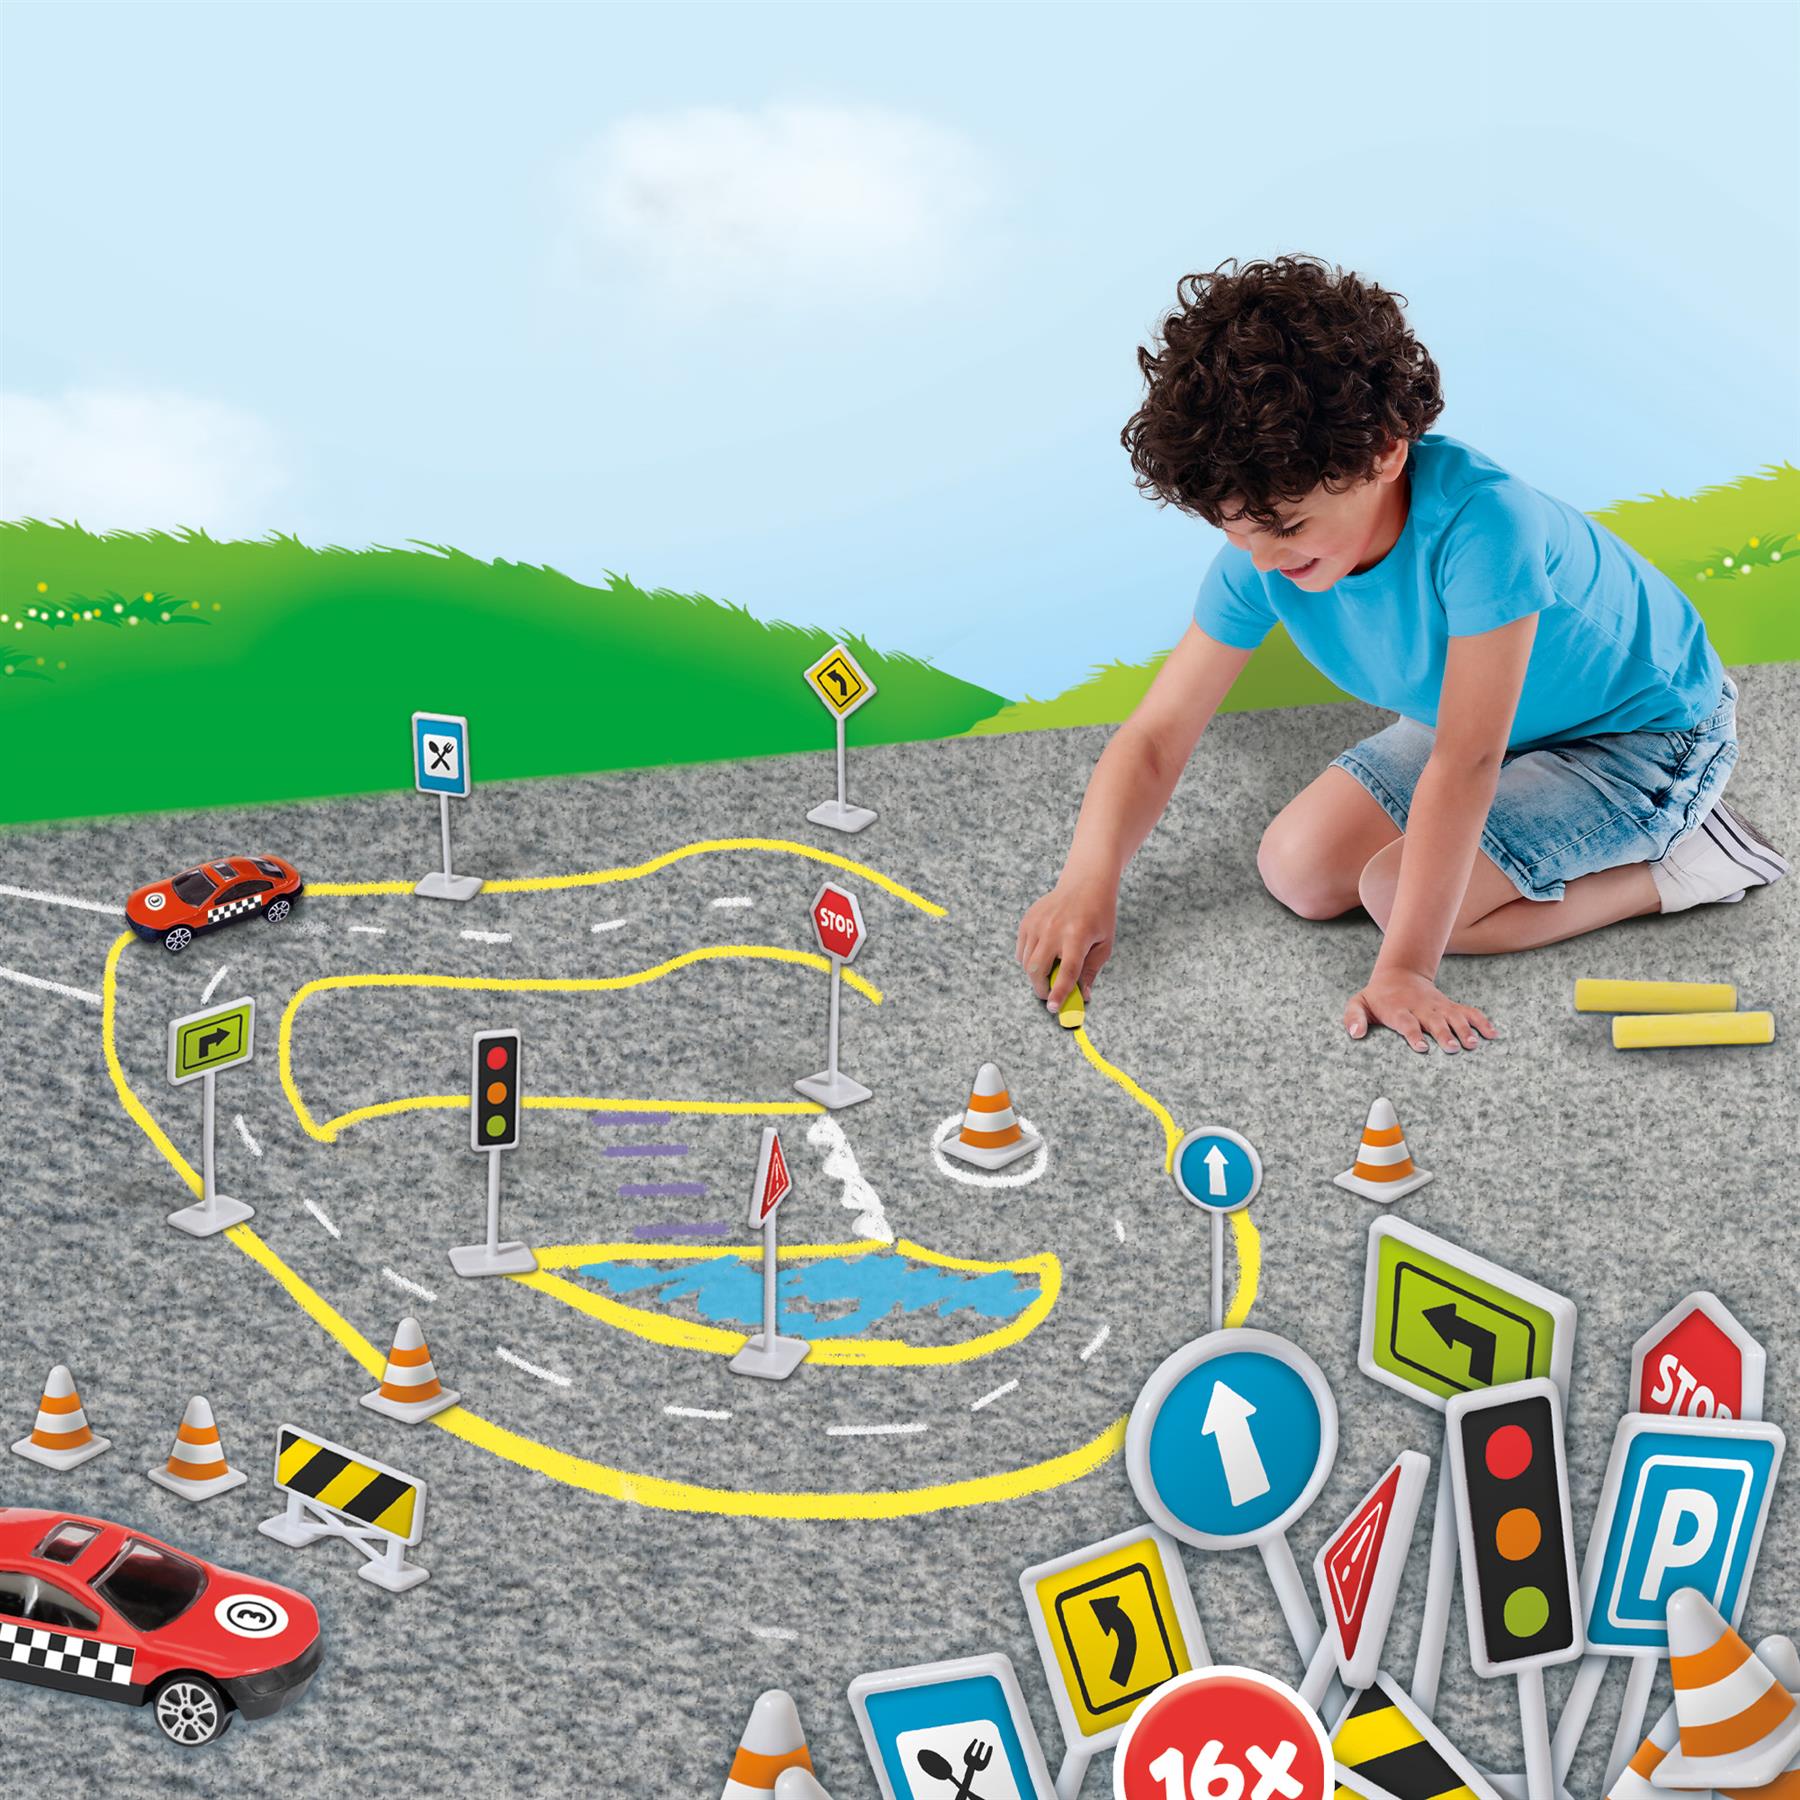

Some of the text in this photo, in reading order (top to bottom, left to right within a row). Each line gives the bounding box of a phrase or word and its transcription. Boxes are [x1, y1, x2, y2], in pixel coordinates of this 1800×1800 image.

[820, 907, 854, 939] STOP
[1639, 1488, 1719, 1601] P
[237, 1609, 267, 1623] 3
